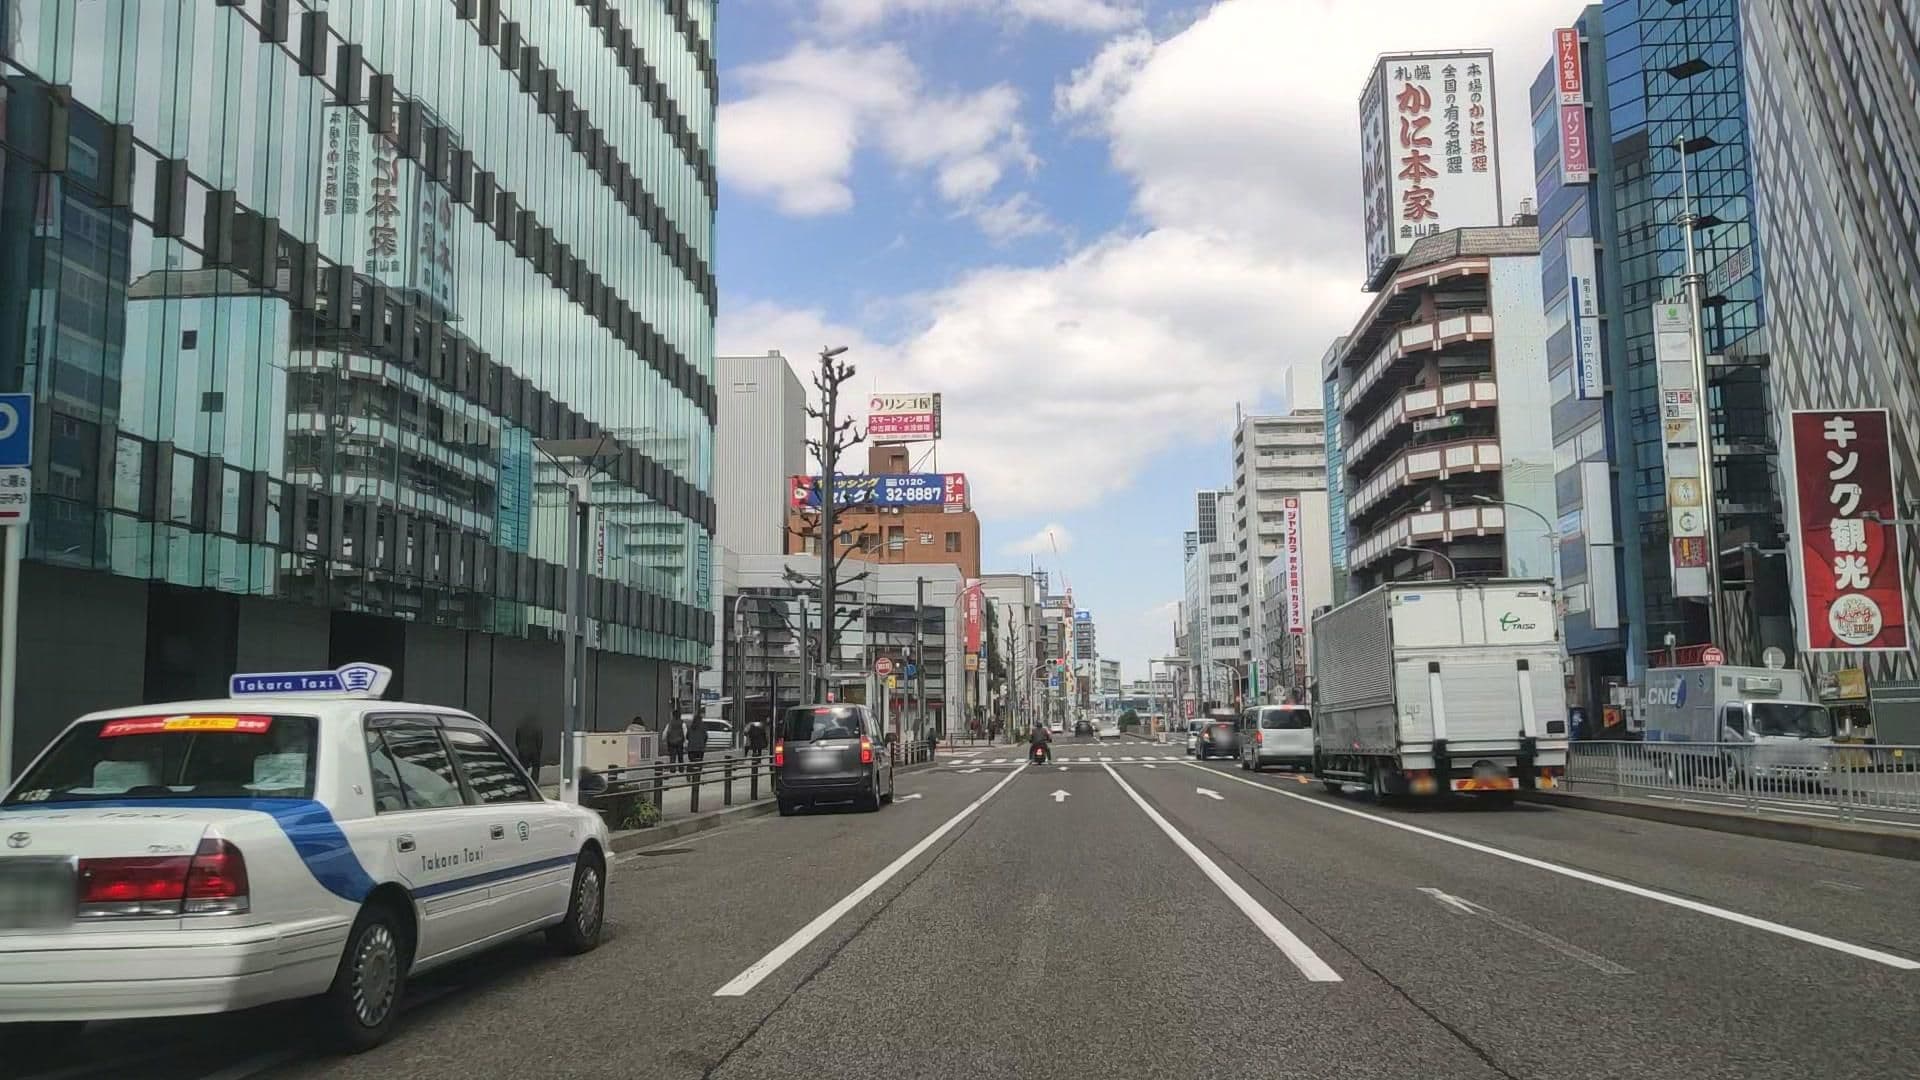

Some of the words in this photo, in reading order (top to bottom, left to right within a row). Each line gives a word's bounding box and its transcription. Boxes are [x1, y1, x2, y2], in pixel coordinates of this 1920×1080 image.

[1395, 64, 1431, 81] 札幌
[1562, 32, 1578, 89] ほけんの窓口
[1564, 93, 1581, 103] 2F
[1441, 64, 1463, 173] 全国の有名料理
[1467, 63, 1488, 172] 本場のかに料理
[1567, 111, 1581, 160] パソコン
[1396, 82, 1439, 222] かに本家
[1400, 223, 1440, 239] 金山店
[885, 397, 931, 410] リンゴ屋
[1823, 416, 1871, 590] キング観光
[1287, 511, 1297, 553] ジャンカラ
[239, 679, 292, 691] Takara
[301, 677, 334, 688] Taxi
[348, 669, 368, 689] 宝
[1648, 688, 1678, 704] CNG
[421, 852, 459, 871] Takara
[464, 846, 485, 864] Taxi
